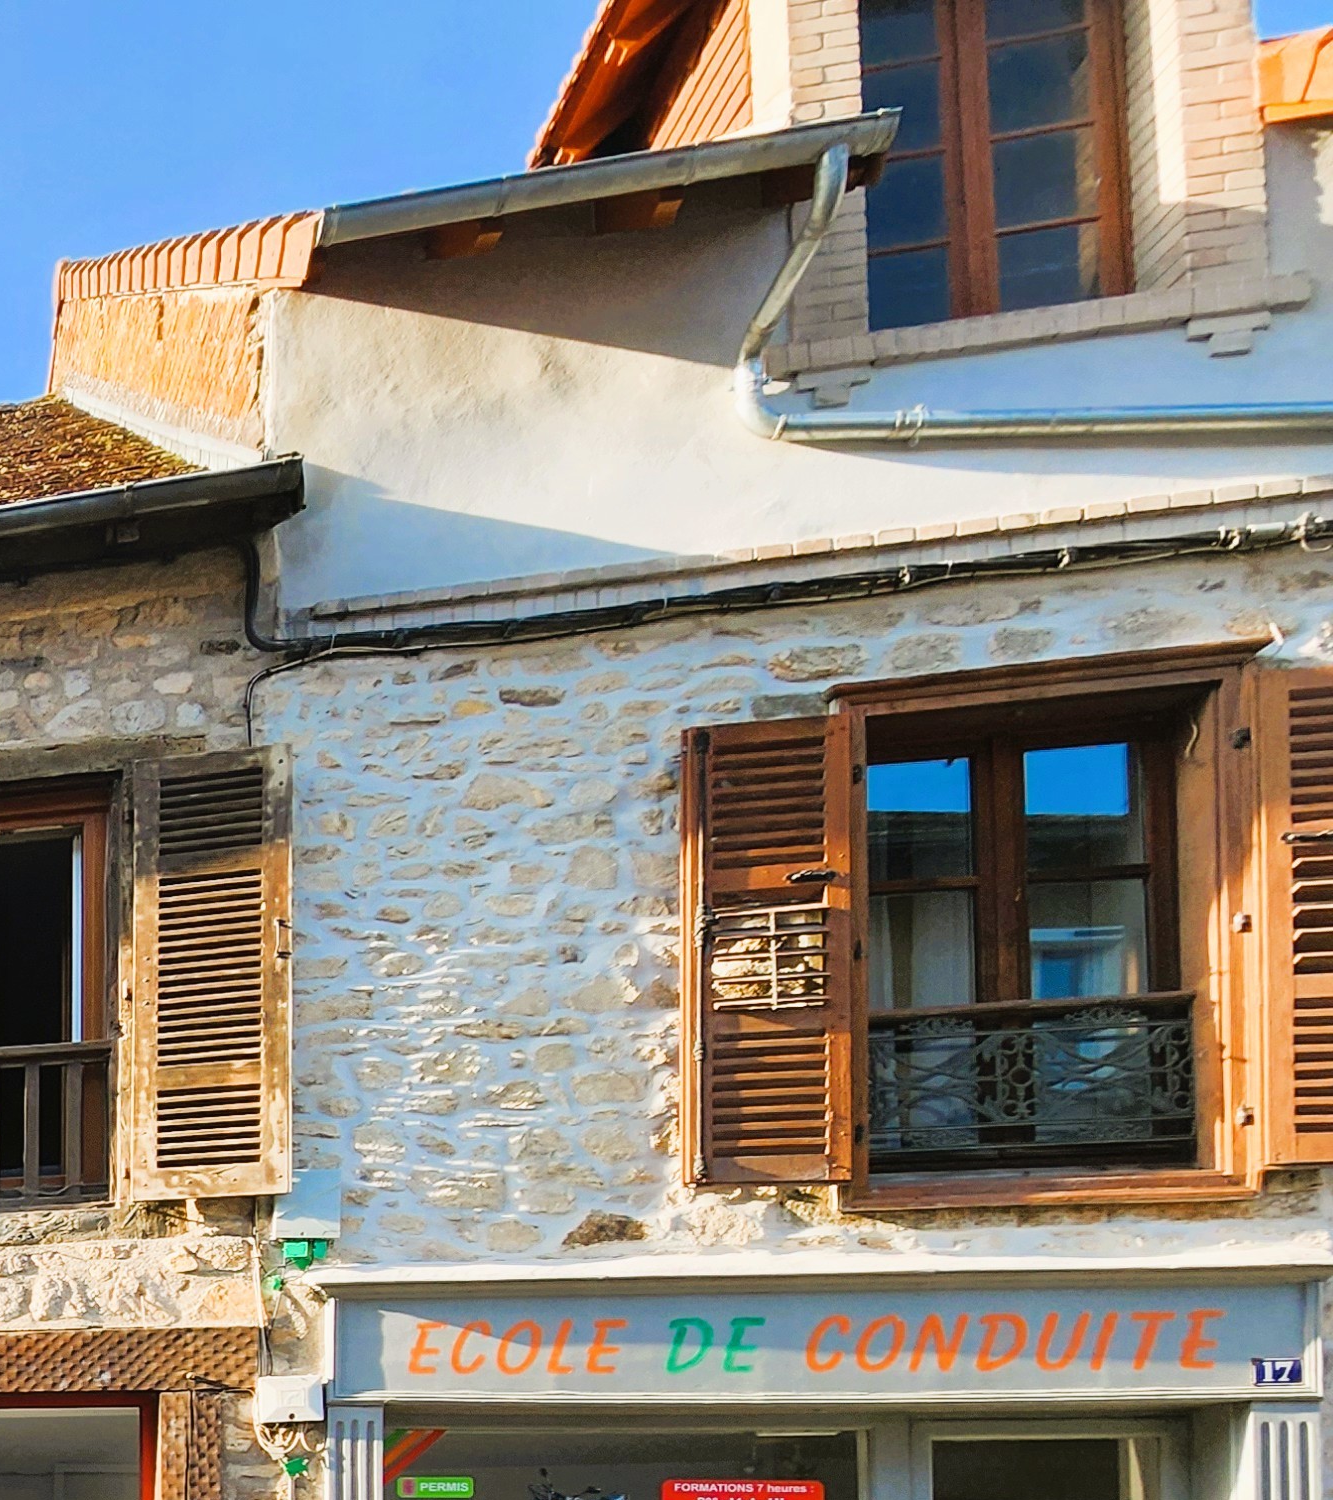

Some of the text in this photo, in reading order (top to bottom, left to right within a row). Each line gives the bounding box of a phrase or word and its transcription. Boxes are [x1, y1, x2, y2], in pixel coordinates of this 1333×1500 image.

[407, 1309, 1226, 1376] ECOLE DE CONDUITE
[1261, 1361, 1295, 1382] 17
[419, 1482, 470, 1492] PERMIS
[674, 1483, 754, 1492] FORMATIONS
[757, 1484, 764, 1492] 7
[767, 1484, 807, 1493] heures
